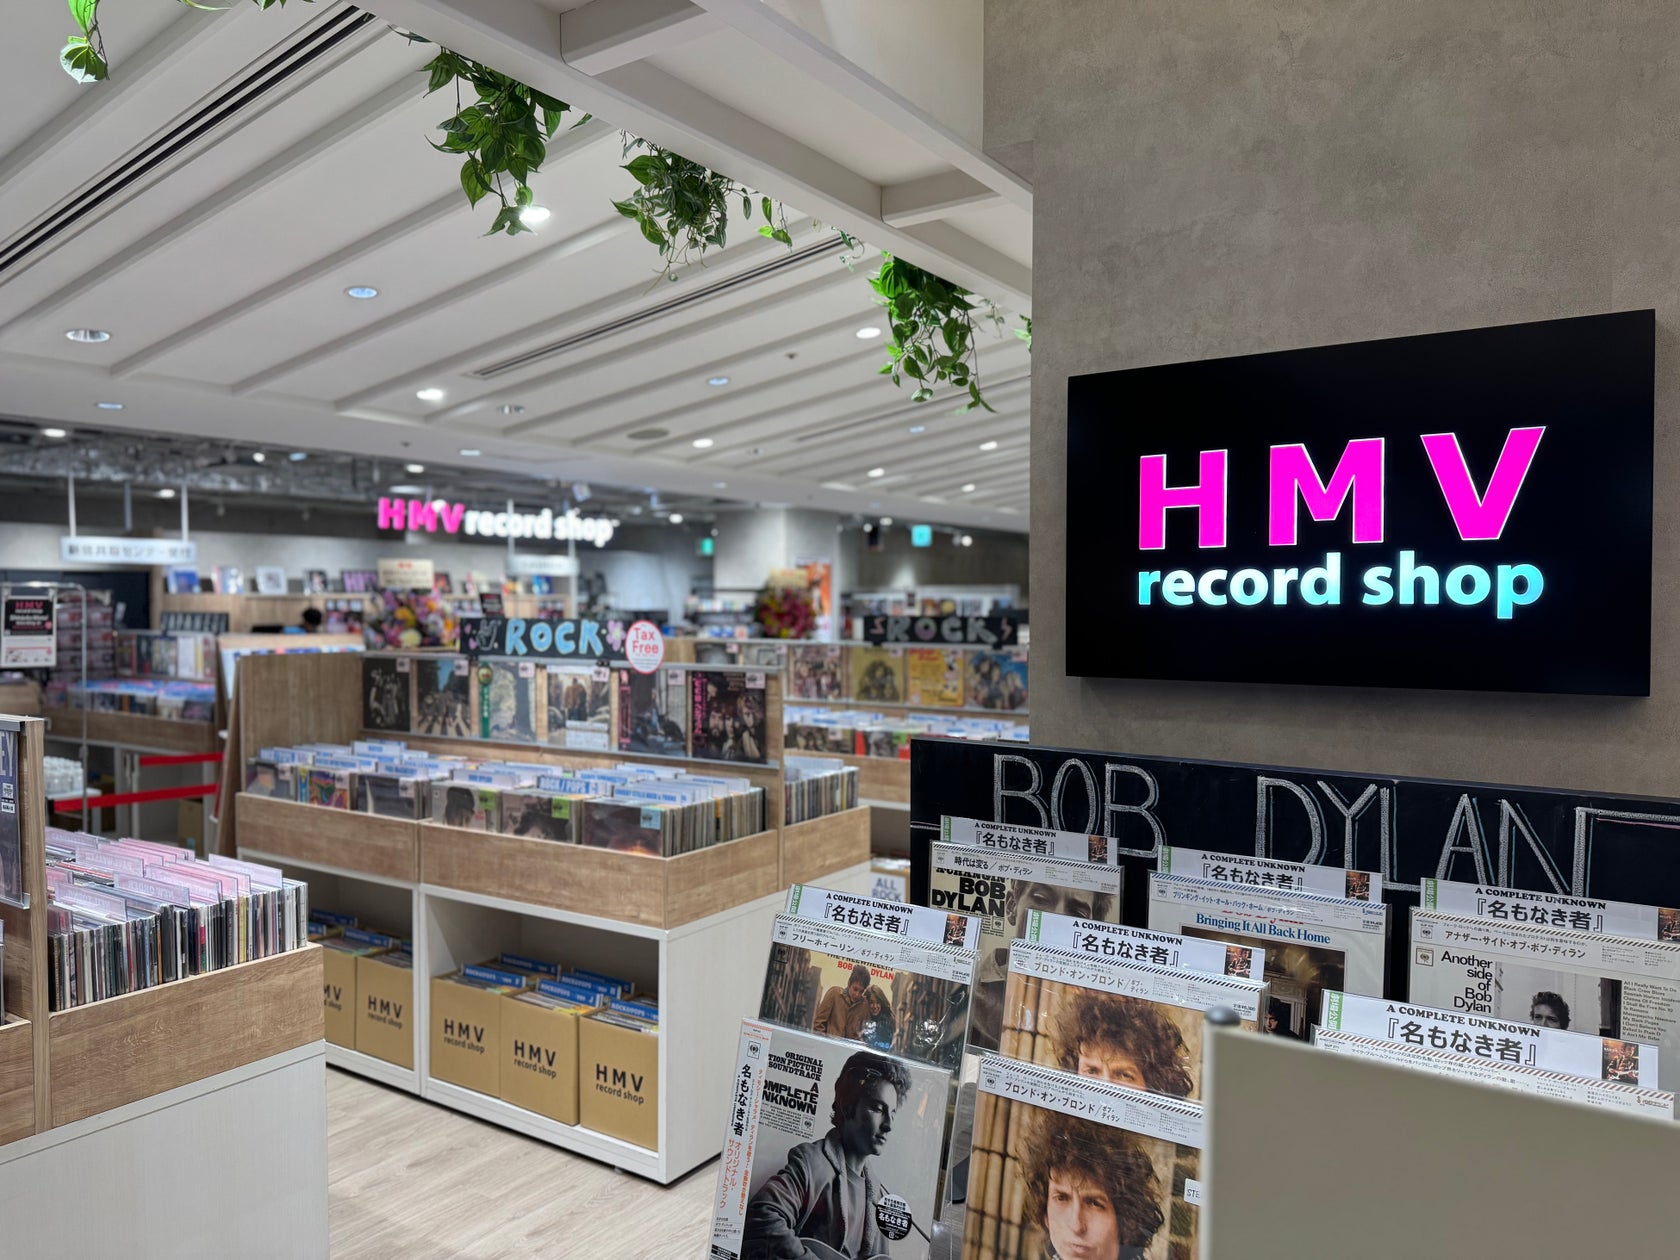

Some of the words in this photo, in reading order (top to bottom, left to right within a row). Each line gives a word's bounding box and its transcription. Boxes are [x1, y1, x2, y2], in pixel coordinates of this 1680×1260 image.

[1139, 426, 1546, 550] HMV
[378, 497, 465, 533] HMV
[464, 508, 553, 538] record
[553, 509, 614, 548] shop
[1138, 552, 1341, 605] record
[1362, 550, 1544, 620] shop
[505, 619, 604, 656] ROCK
[634, 627, 655, 641] Tax
[886, 617, 998, 643] ROCK
[632, 640, 659, 654] Free
[981, 823, 1018, 833] COMPLETE
[1018, 828, 1057, 838] UNKNOWN
[993, 753, 1168, 857] BOB
[1255, 776, 1590, 900] DYLAN
[1210, 855, 1256, 867] COMPLETE
[1257, 860, 1306, 873] UNKNOWN
[959, 877, 1006, 900] BOB
[833, 894, 871, 908] COMPLETE
[872, 901, 914, 915] UNKNOWN
[932, 888, 1005, 917] DYLAN
[1485, 889, 1542, 903] COMPLETE
[1545, 896, 1607, 911] UNKNOWN
[1073, 920, 1080, 928] A
[1082, 921, 1130, 937] COMPLETE
[1131, 929, 1183, 946] UNKNOWN
[1196, 912, 1241, 933] Bringing
[1242, 920, 1250, 932] It
[1250, 921, 1267, 935] All
[1269, 925, 1295, 939] Back
[1297, 928, 1331, 944] Home
[1445, 930, 1586, 959] アナザー・サイド・オブ・ボブ・ディラン
[837, 960, 853, 971] BOB
[1441, 950, 1494, 969] Another
[871, 968, 895, 981] DYLAN
[1467, 966, 1493, 981] side
[324, 985, 342, 1001] MV
[1465, 987, 1493, 1003] Bob
[1478, 980, 1490, 992] of
[367, 994, 402, 1019] HMV
[1453, 996, 1492, 1014] Dylan
[444, 1018, 485, 1044] HMV
[1386, 1004, 1395, 1013] A
[1399, 1006, 1466, 1026] COMPLETE
[1469, 1017, 1541, 1038] UNKNOWN
[444, 1035, 466, 1050] record
[467, 1039, 485, 1055] shop
[514, 1040, 556, 1067] HMV
[514, 1057, 537, 1073] record
[538, 1063, 557, 1079] shop
[768, 1053, 787, 1065] TION
[787, 1059, 823, 1075] PICTURE
[785, 1051, 824, 1068] ORIGINAL
[596, 1063, 645, 1092] HMV
[768, 1061, 822, 1081] SOUNDTRACK
[596, 1082, 622, 1098] record
[623, 1088, 645, 1106] shop
[764, 1079, 819, 1105] MPLETE
[810, 1082, 819, 1093] A
[733, 1063, 752, 1137] 名もなき者
[761, 1090, 818, 1116] NKNOWN
[720, 1138, 735, 1209] サウンドトラック
[1186, 1188, 1201, 1199] STE
[879, 1212, 909, 1228] 名もなき者
